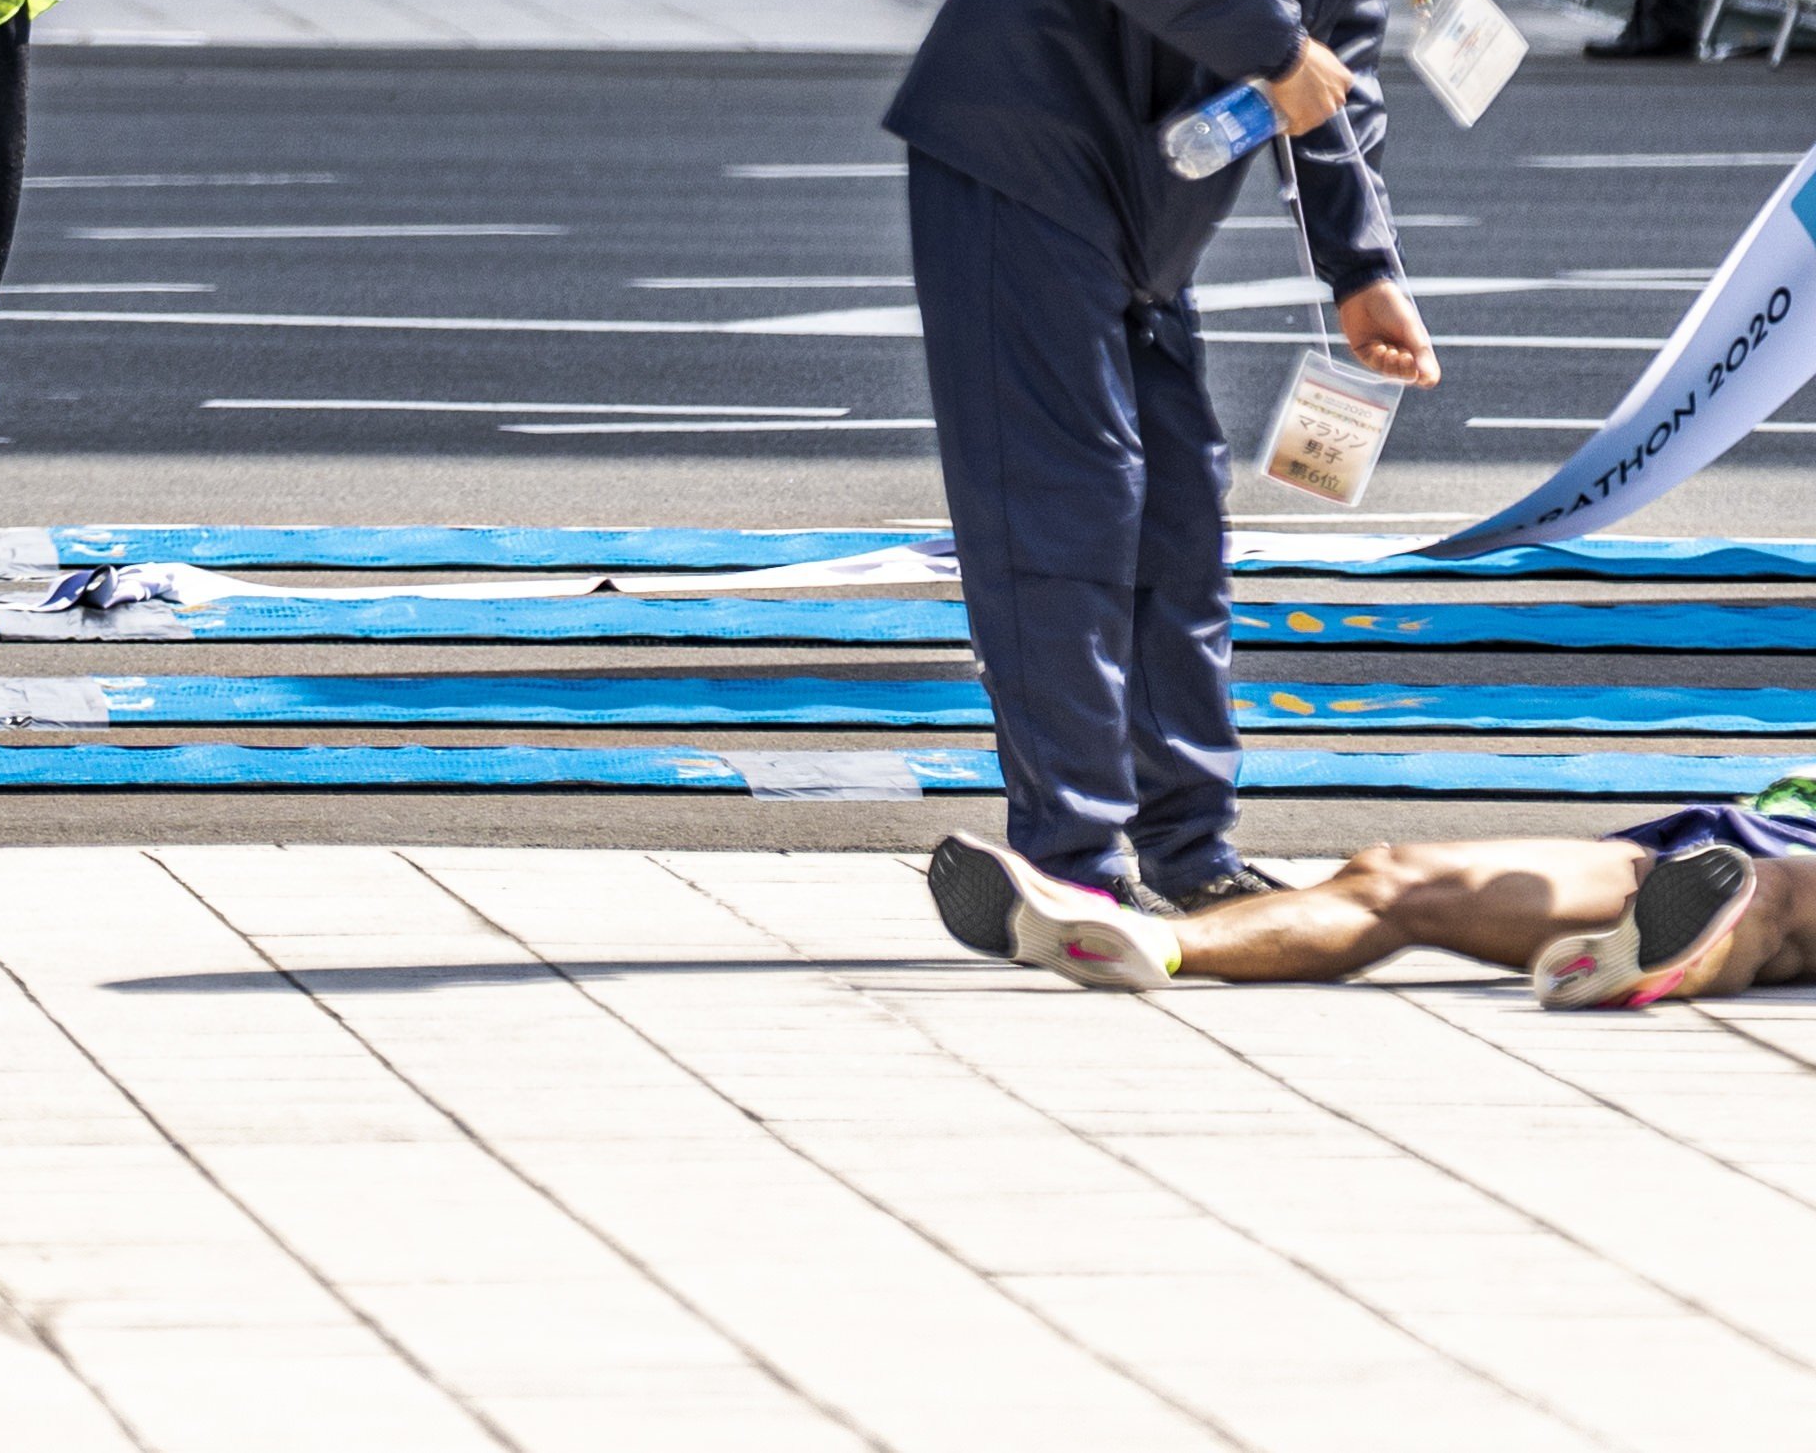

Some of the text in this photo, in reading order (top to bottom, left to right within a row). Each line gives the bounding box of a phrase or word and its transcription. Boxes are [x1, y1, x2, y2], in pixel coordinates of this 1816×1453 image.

[1708, 286, 1792, 397] 2020
[1298, 414, 1368, 448] マラソン
[1302, 439, 1344, 464] 男子
[1288, 459, 1341, 492] 第6位
